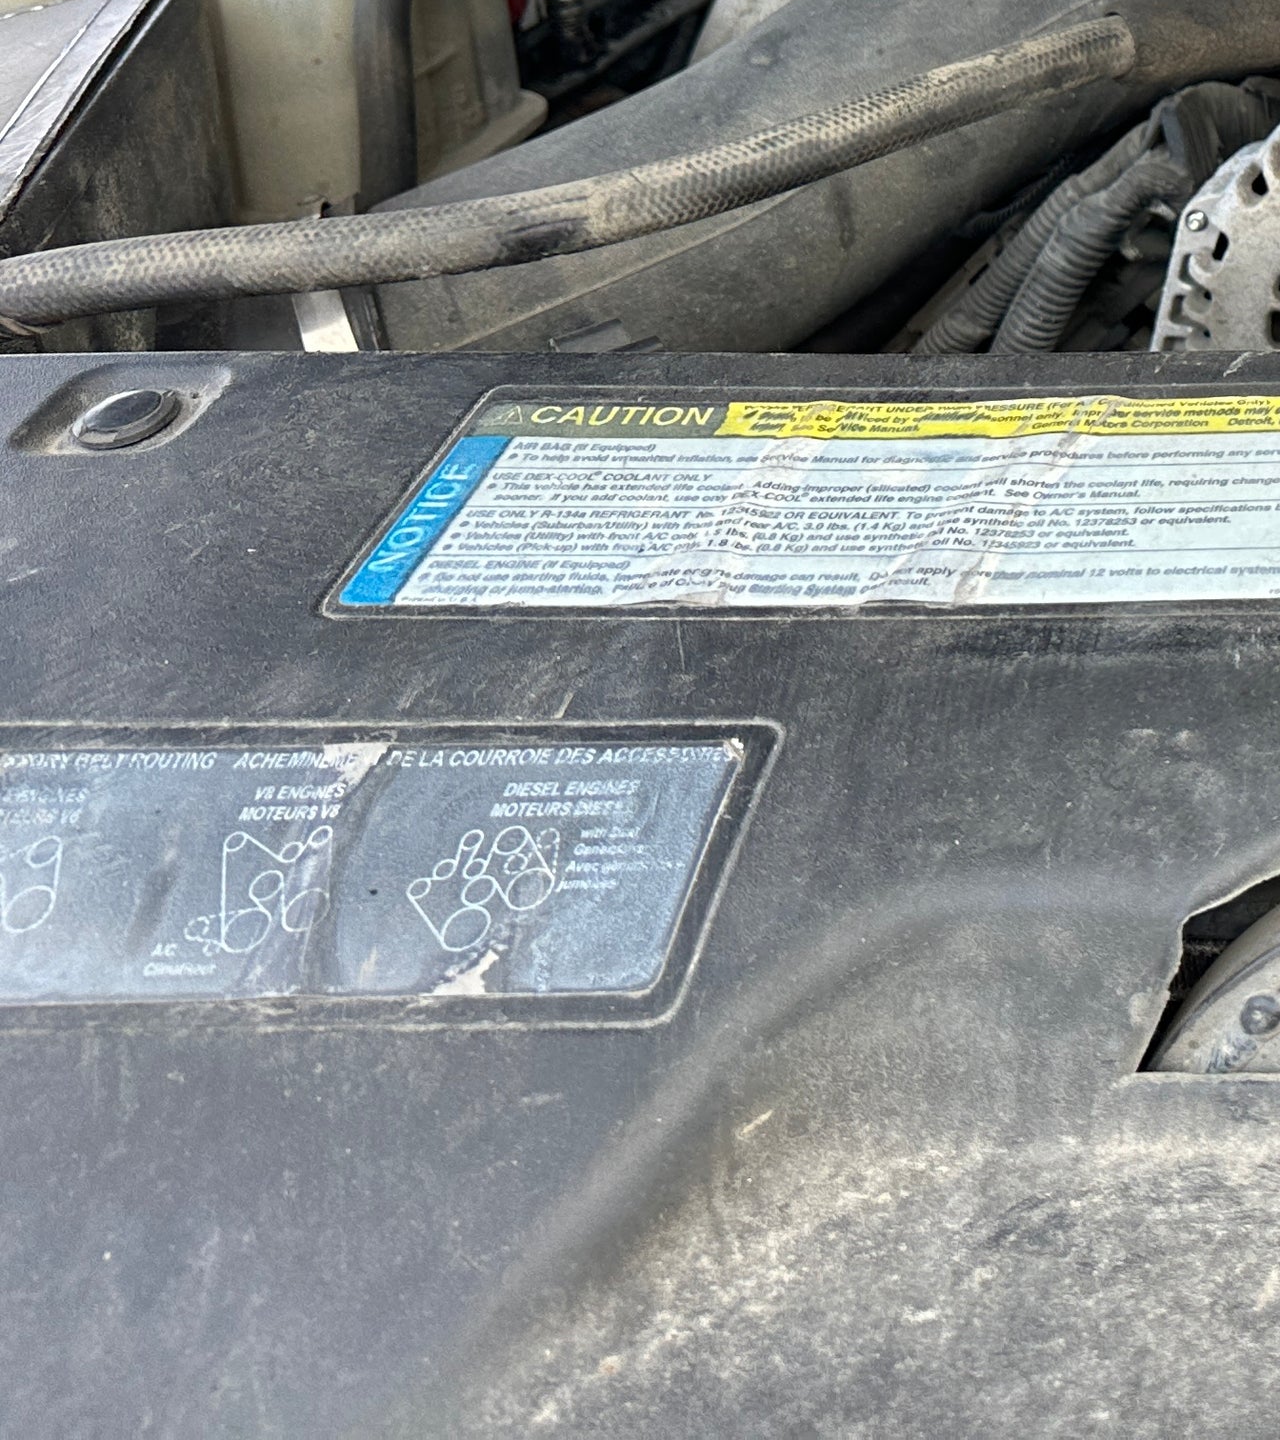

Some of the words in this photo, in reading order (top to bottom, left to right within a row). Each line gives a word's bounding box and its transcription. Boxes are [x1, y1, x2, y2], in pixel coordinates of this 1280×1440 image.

[530, 405, 714, 427] CAUTION
[1131, 419, 1209, 429] Corporation
[1228, 417, 1274, 427] Detroit,
[543, 453, 569, 464] help
[574, 454, 609, 462] avoid
[811, 455, 862, 464] Manual
[863, 455, 882, 464] for
[1107, 450, 1150, 460] before
[1152, 449, 1224, 460] performing
[1228, 449, 1252, 459] any
[590, 443, 657, 453] Equipped)
[492, 472, 522, 481] USE
[602, 472, 670, 481] COOLANT
[672, 472, 713, 482] ONLY
[502, 482, 531, 491] This
[534, 482, 580, 491] vehicle
[582, 482, 606, 491] has
[609, 482, 672, 491] extended
[672, 482, 695, 491] life
[752, 480, 800, 493] Adding
[1010, 477, 1060, 489] shorten
[1063, 479, 1086, 489] the
[1087, 478, 1138, 490] coolant
[1141, 478, 1165, 488] life,
[1168, 476, 1229, 488] requiring
[1231, 476, 1280, 487] change
[562, 494, 590, 504] you
[590, 494, 616, 502] add
[809, 494, 871, 502] extended
[872, 494, 898, 503] life
[899, 494, 944, 505] engine
[1003, 488, 1029, 498] See
[1088, 489, 1142, 499] Manual.
[367, 462, 477, 574] NOTICE
[464, 510, 496, 518] USE
[498, 510, 538, 518] ONLY
[588, 510, 691, 518] REFRIGERANT
[783, 511, 806, 520] OR
[906, 511, 924, 520] To
[977, 505, 1030, 518] damage
[1048, 507, 1075, 517] A/C
[1077, 507, 1130, 517] system,
[1133, 505, 1176, 515] follow
[1177, 503, 1273, 515] specifications
[474, 521, 530, 529] Vehicles
[651, 521, 681, 529] with
[714, 516, 743, 527] and
[803, 522, 825, 531] 3.0
[853, 522, 881, 532] (1.4
[882, 522, 907, 533] Kg)
[908, 521, 934, 530] and
[963, 516, 1025, 528] synthetic
[1026, 520, 1045, 528] oil
[1048, 518, 1071, 527] No.
[1157, 514, 1232, 526] equivalent.
[464, 531, 522, 540] Vehicles
[523, 531, 575, 541] (Utility)
[643, 531, 669, 541] A/C
[780, 532, 805, 543] Kg)
[806, 532, 833, 541] and
[835, 533, 862, 541] use
[945, 526, 969, 536] No.
[1054, 528, 1130, 539] equivalent.
[457, 543, 514, 552] Vehicles
[515, 543, 579, 553] (Pick-up)
[580, 543, 610, 552] with
[648, 543, 674, 552] A/C
[783, 543, 809, 554] Kg)
[811, 543, 839, 552] and
[839, 544, 866, 552] use
[931, 537, 950, 547] oil
[951, 537, 976, 547] No.
[1060, 539, 1136, 549] equivalent.
[428, 560, 481, 570] DIESEL
[484, 560, 541, 570] ENGINE
[560, 560, 631, 571] Equipped)
[733, 572, 787, 583] damage
[789, 573, 816, 582] can
[916, 565, 957, 577] apply
[1088, 567, 1106, 577] 12
[1108, 565, 1143, 577] volts
[1163, 564, 1226, 576] electrical
[128, 751, 217, 770] ROUTING
[387, 750, 414, 768] DE
[418, 750, 444, 767] LA
[450, 748, 551, 767] COURROIE
[558, 747, 596, 765] DES
[254, 786, 275, 801] V8
[277, 783, 347, 800] ENGINES
[503, 781, 561, 798] DIESEL
[564, 779, 642, 797] ENGINES
[238, 805, 318, 822] MOTEURS
[321, 804, 343, 819] V8
[490, 801, 571, 818] MOTEURS
